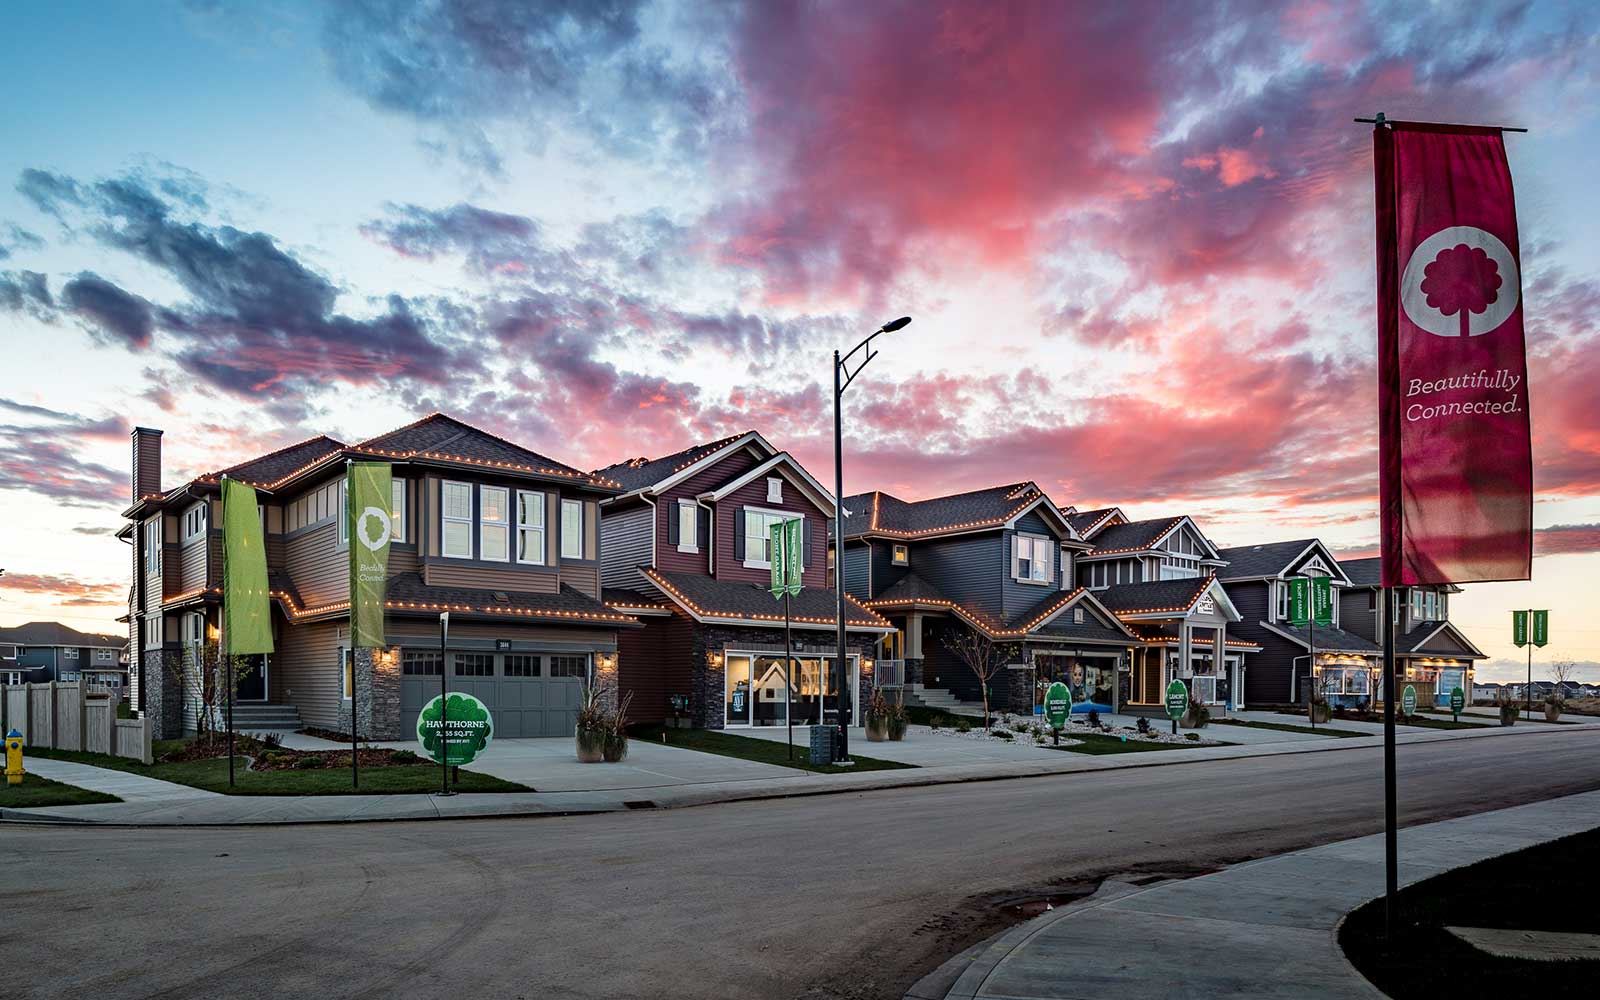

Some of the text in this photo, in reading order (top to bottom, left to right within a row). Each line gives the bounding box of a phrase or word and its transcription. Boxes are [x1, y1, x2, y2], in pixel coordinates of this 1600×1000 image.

[1406, 369, 1520, 397] Beautifully
[1406, 394, 1521, 421] Connected.
[426, 720, 485, 728] HAWTHORNE
